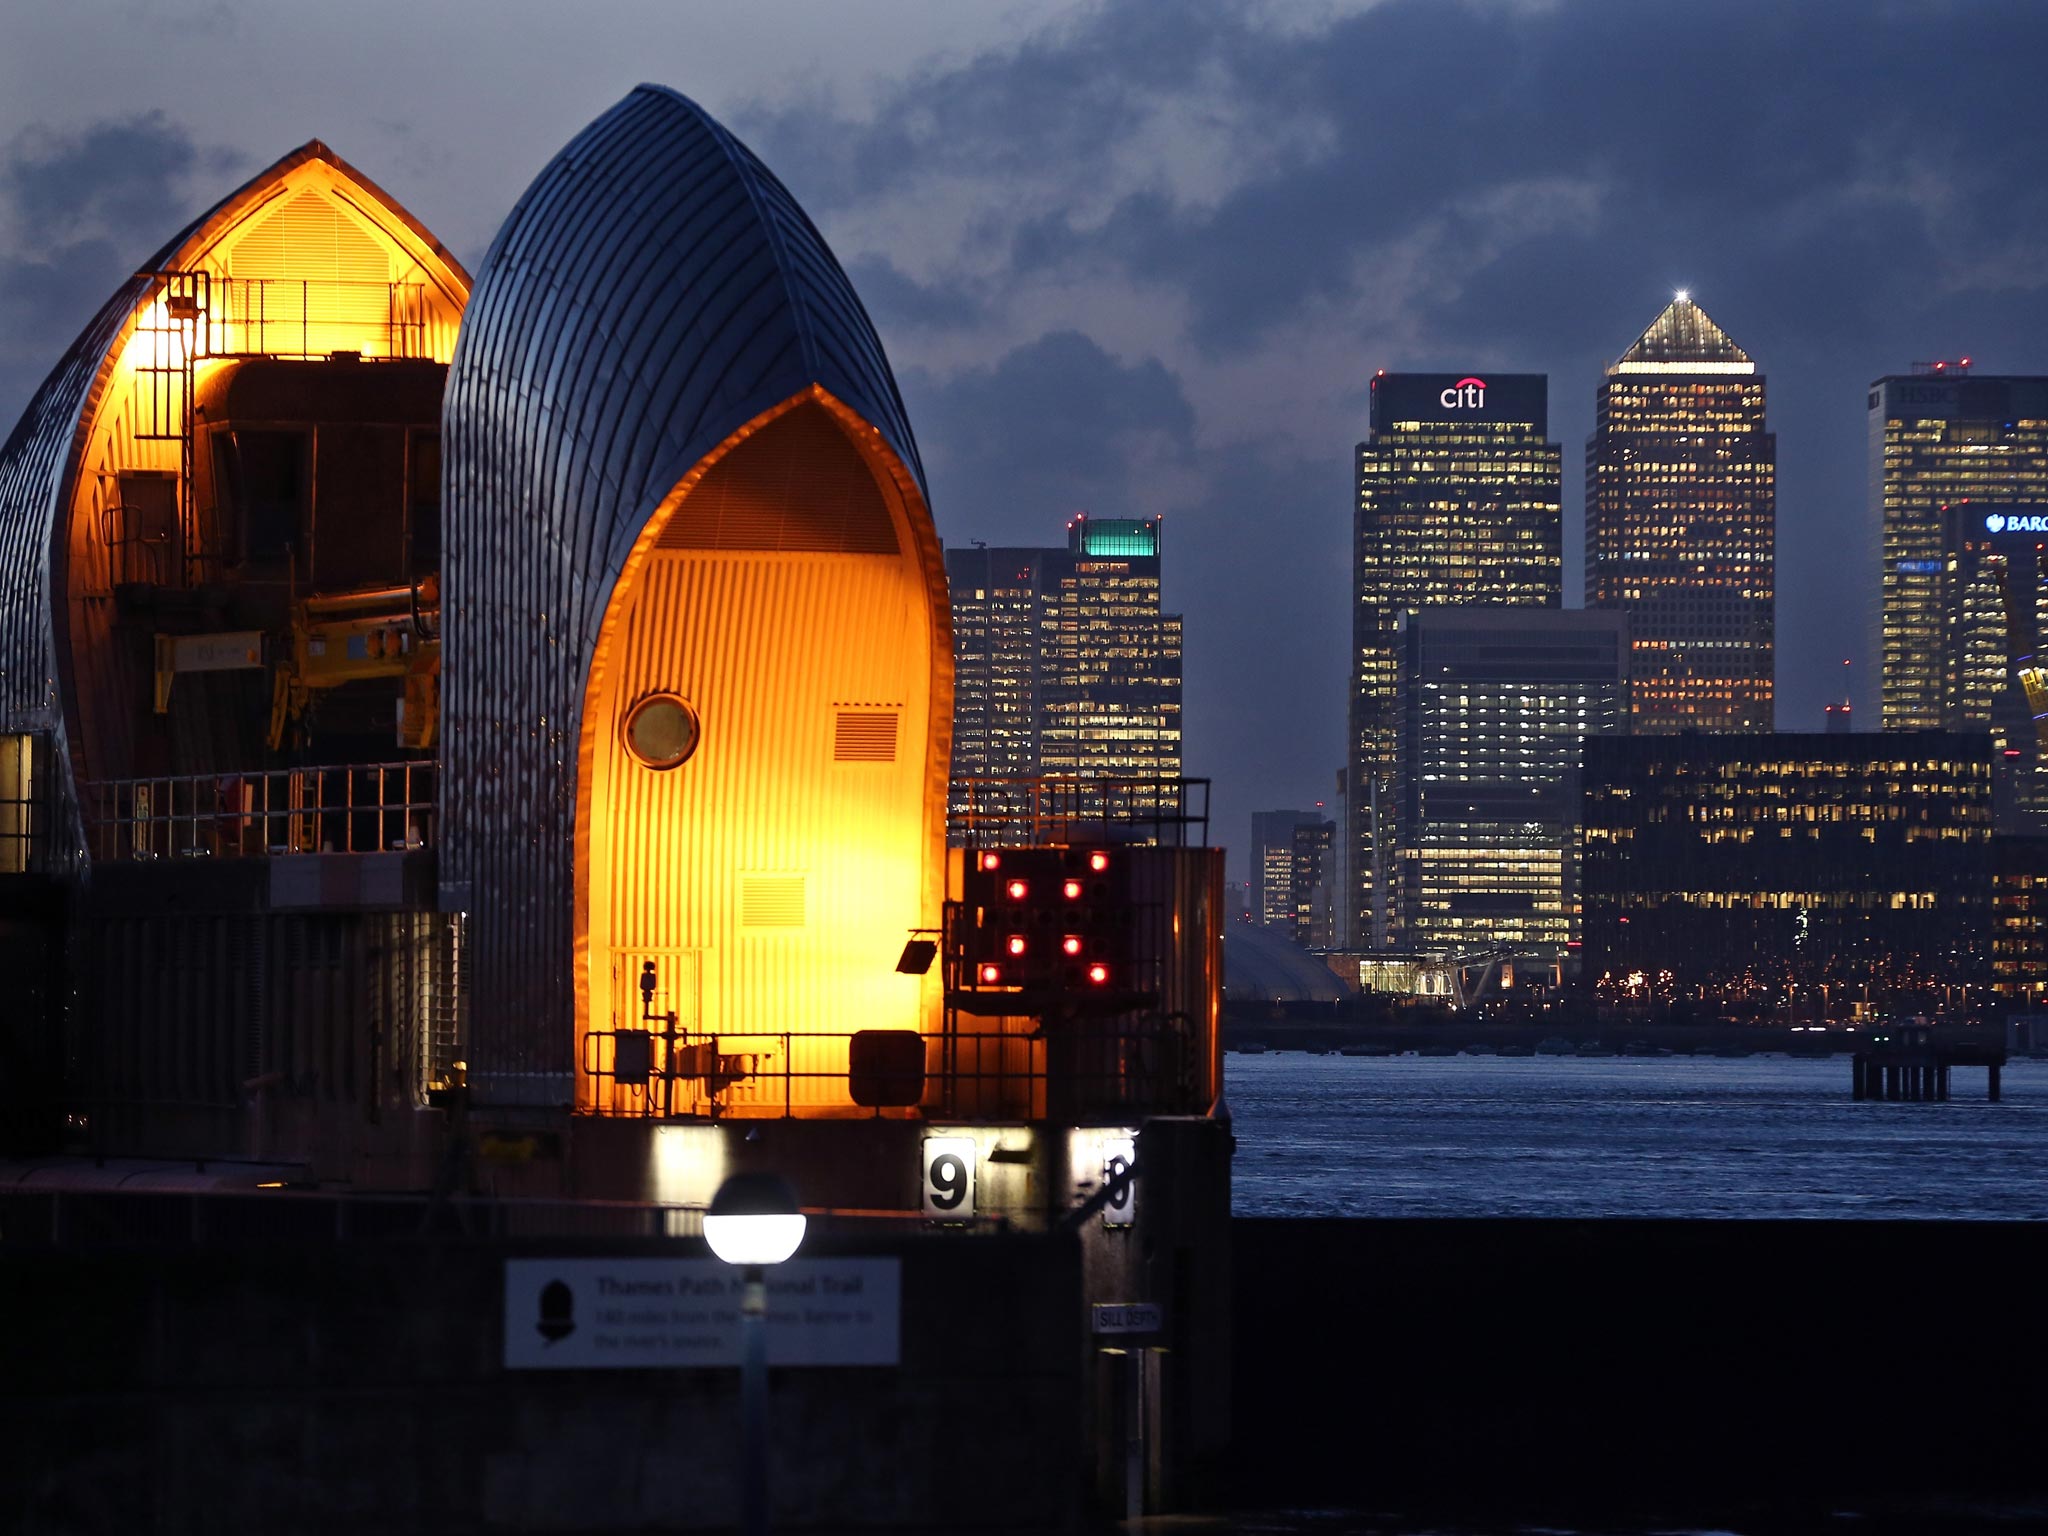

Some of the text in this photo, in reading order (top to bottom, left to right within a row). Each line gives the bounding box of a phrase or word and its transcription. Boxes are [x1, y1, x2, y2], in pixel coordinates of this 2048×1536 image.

[1440, 380, 1486, 408] citi
[930, 1154, 967, 1211] 9
[597, 1275, 673, 1296] Thames
[679, 1275, 725, 1296] Path
[821, 1274, 864, 1296] Trail
[1100, 1310, 1123, 1328] SILL
